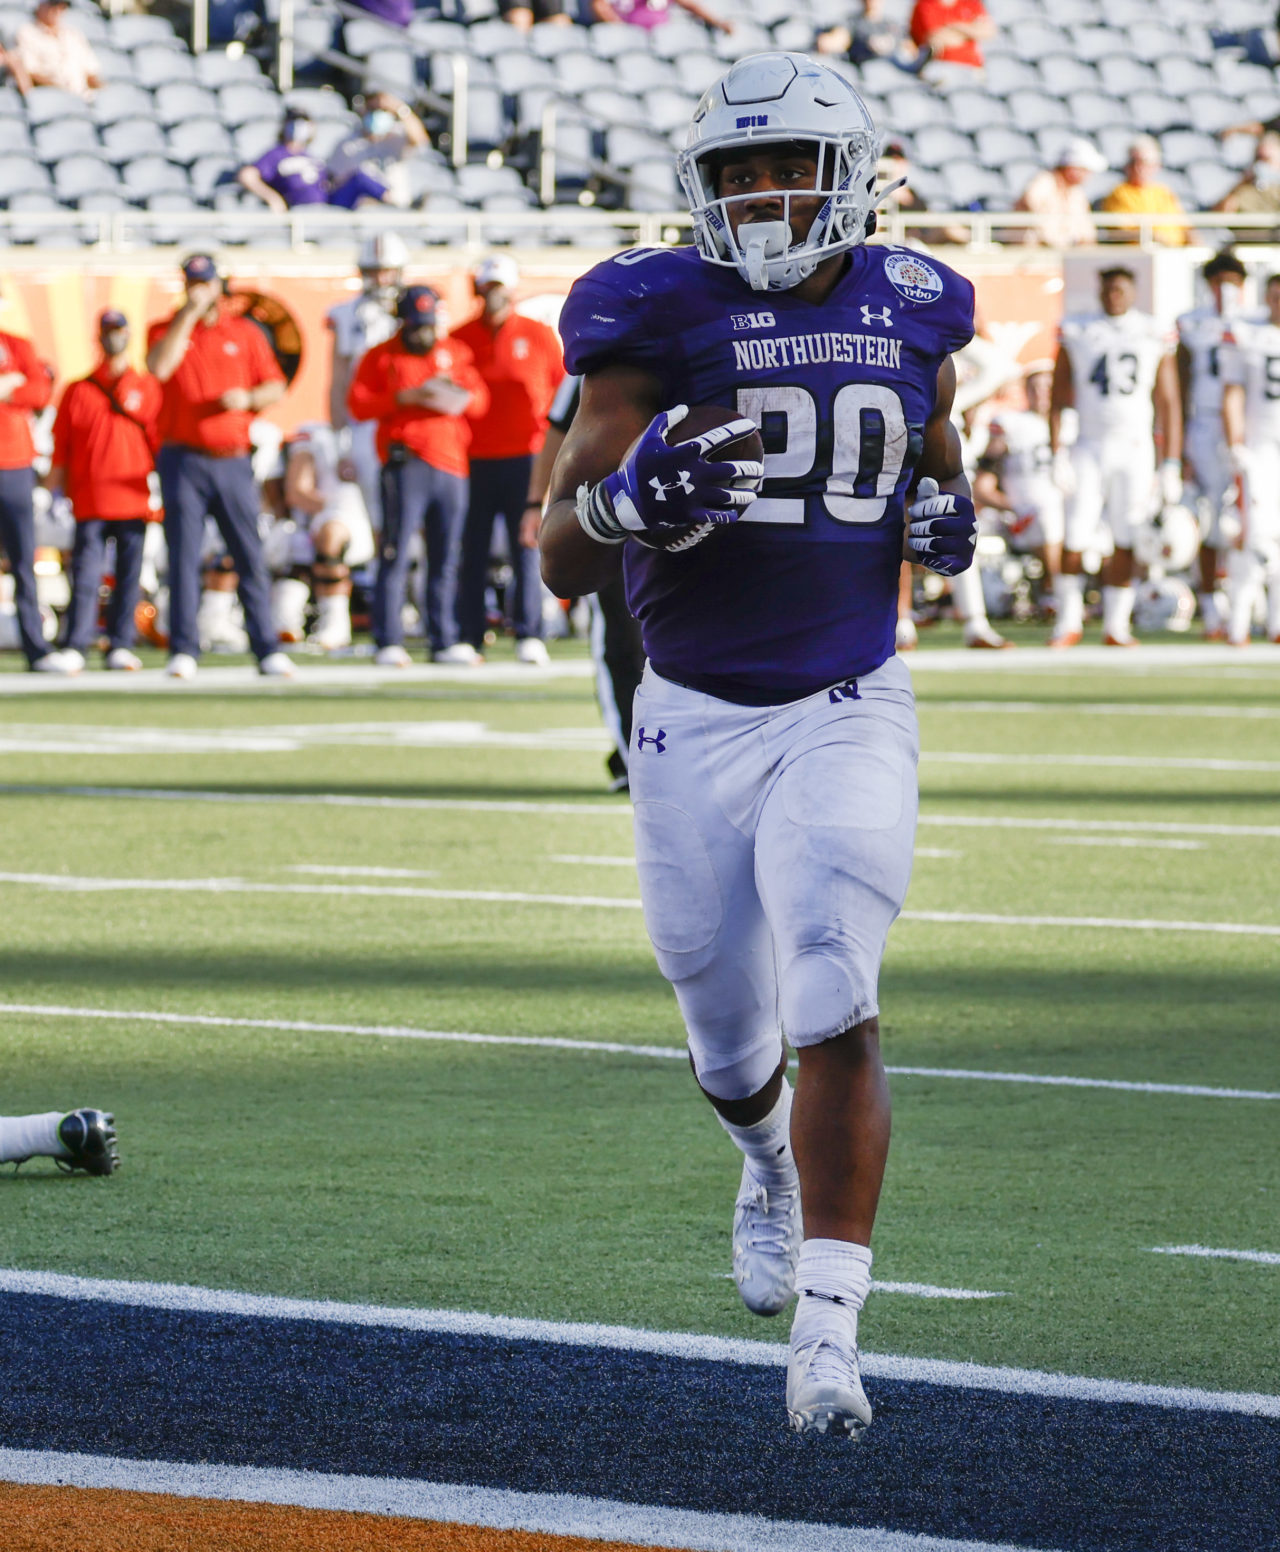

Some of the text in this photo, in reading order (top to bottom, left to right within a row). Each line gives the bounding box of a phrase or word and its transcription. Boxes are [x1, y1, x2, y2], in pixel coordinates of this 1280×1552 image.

[886, 255, 935, 277] CITRUS BOWL
[903, 286, 932, 300] Vrbo
[731, 311, 776, 331] B1G
[732, 332, 903, 371] NORTHWESTERN
[1090, 353, 1138, 396] 43
[735, 382, 908, 524] 20
